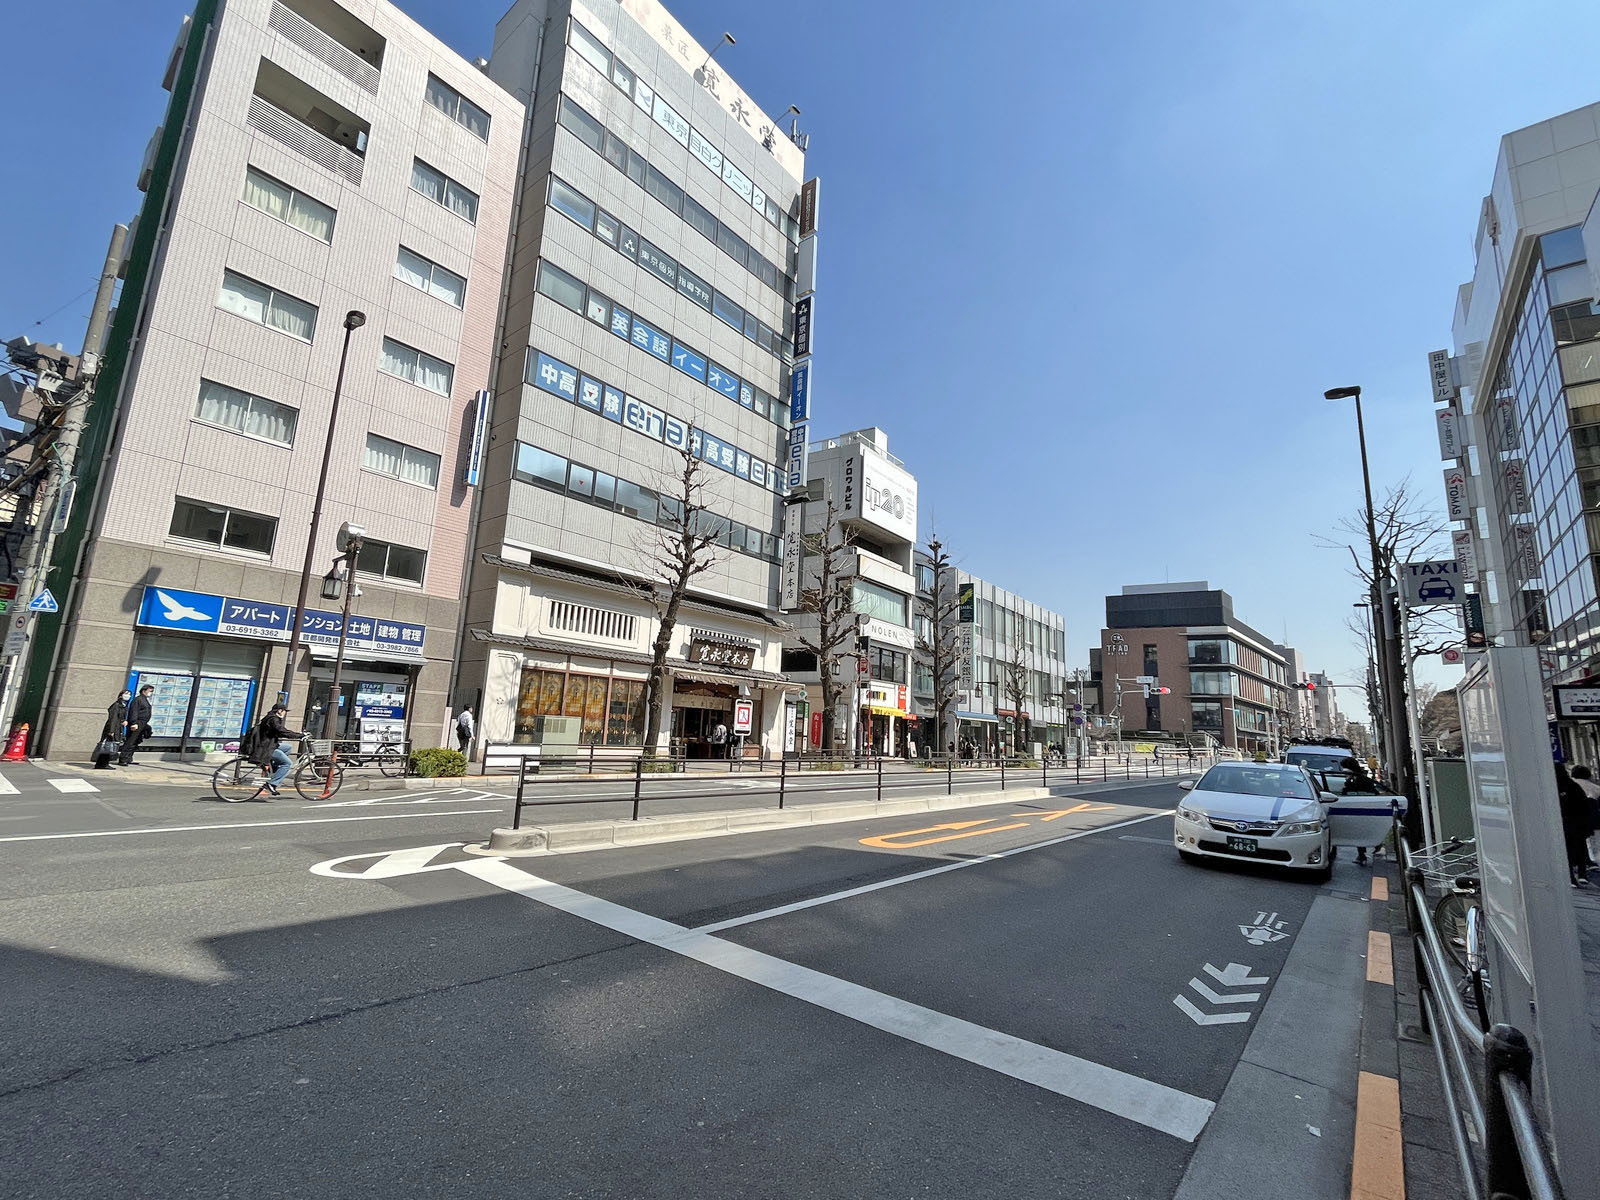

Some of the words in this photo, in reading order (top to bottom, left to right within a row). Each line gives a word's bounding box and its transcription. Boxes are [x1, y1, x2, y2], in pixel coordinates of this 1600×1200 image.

[663, 109, 764, 206] 東京目白クリニック
[611, 312, 736, 392] 英会話イーオン
[540, 363, 621, 415] 中高受験
[1433, 353, 1449, 397] 田中屋ビル
[1449, 484, 1462, 515] TOMAS
[1409, 562, 1458, 576] TAXI
[226, 625, 279, 637] 03-6915-3362
[230, 605, 280, 624] アパート
[293, 613, 343, 631] ンション
[348, 622, 371, 636] 土地
[377, 625, 398, 639] 建物
[401, 628, 422, 642] 管理
[302, 634, 360, 646] 首都開発株会社
[871, 625, 898, 640] NOLEN
[961, 626, 971, 684] 三井住友銀行
